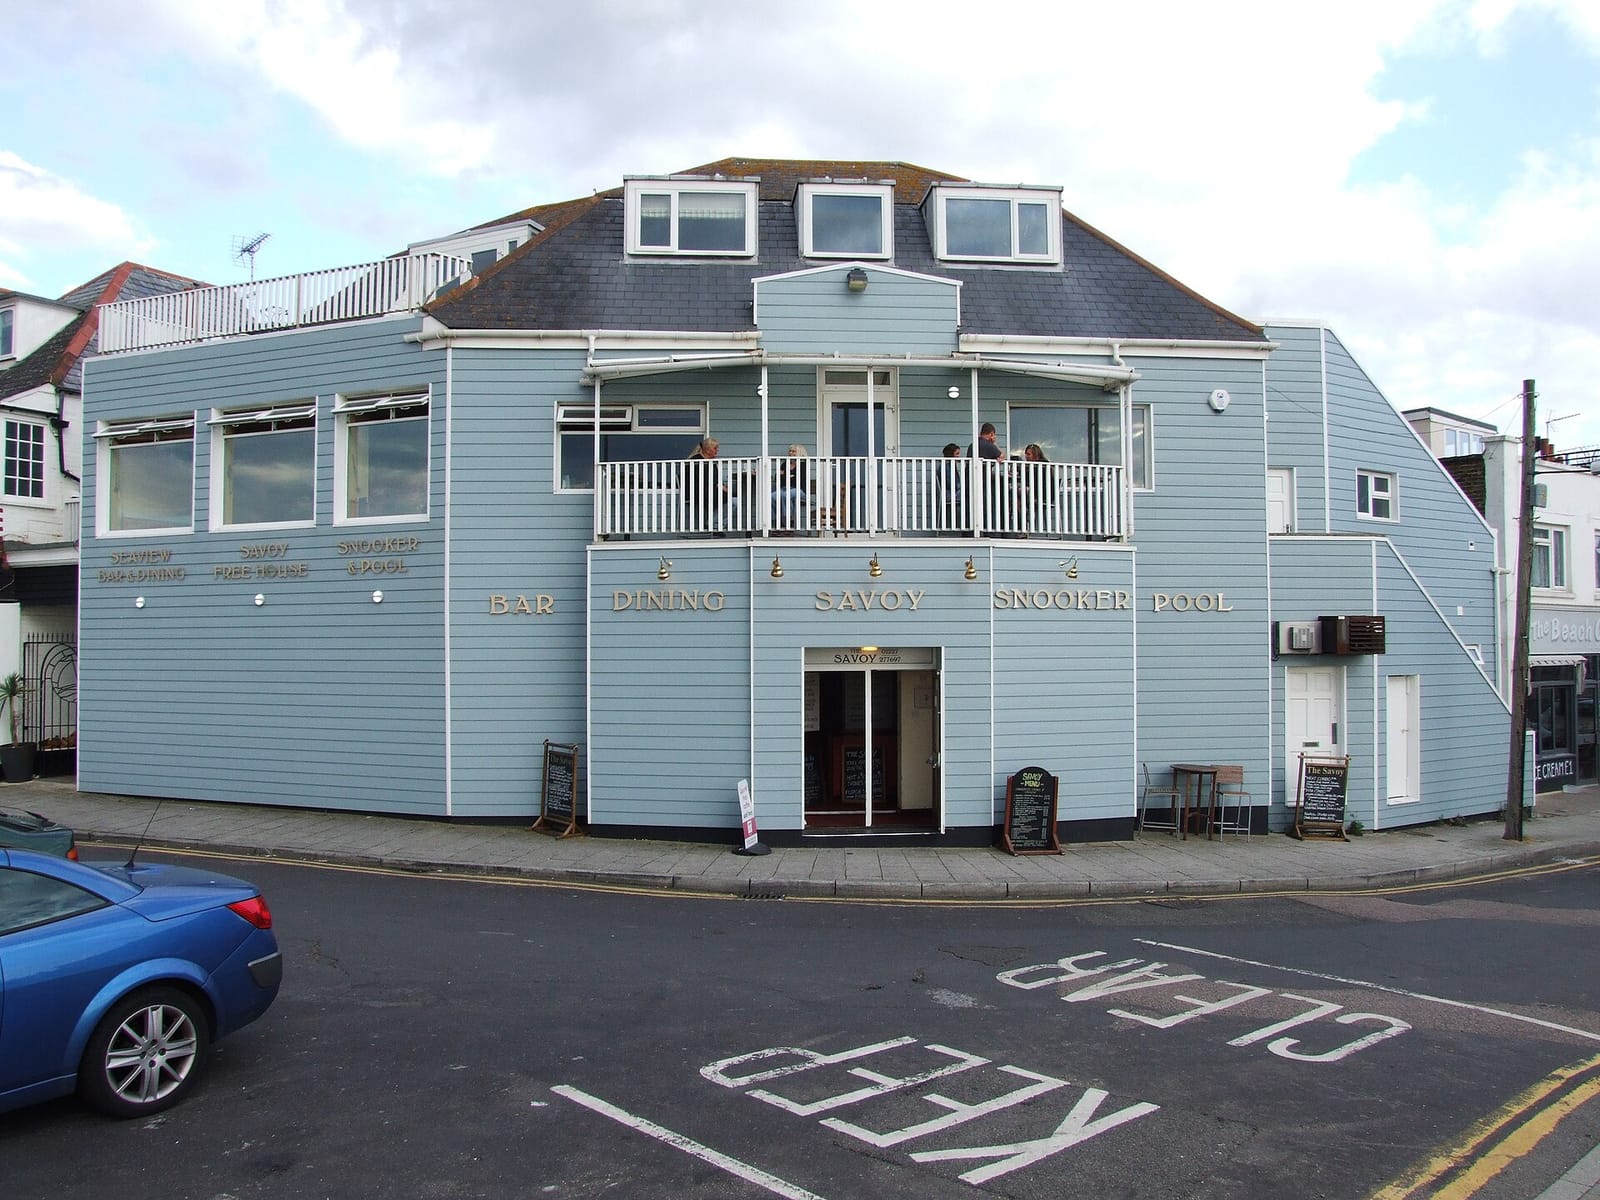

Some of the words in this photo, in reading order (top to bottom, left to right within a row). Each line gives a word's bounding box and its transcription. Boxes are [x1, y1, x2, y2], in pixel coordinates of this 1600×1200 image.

[240, 543, 289, 558] SAVOY
[338, 536, 420, 554] SNOOKER
[111, 550, 171, 564] SEAVIEW
[98, 569, 123, 583] BAR
[137, 567, 185, 582] DINING
[214, 565, 252, 580] FREE
[255, 563, 309, 578] HOUSE
[360, 559, 409, 574] POOL
[489, 594, 555, 615] BAR
[612, 589, 727, 612] DINING
[814, 589, 926, 611] SAVOY
[994, 587, 1131, 610] SNOOKER
[1152, 592, 1233, 613] POOL
[1551, 617, 1592, 642] Beach
[834, 653, 877, 664] SAVOY
[1022, 772, 1043, 780] SAVOY
[1307, 766, 1321, 775] The
[1322, 766, 1345, 777] Savoy
[1542, 761, 1564, 779] CREAM
[995, 950, 1412, 1063] CLEAR
[699, 1035, 1161, 1185] KEEP
